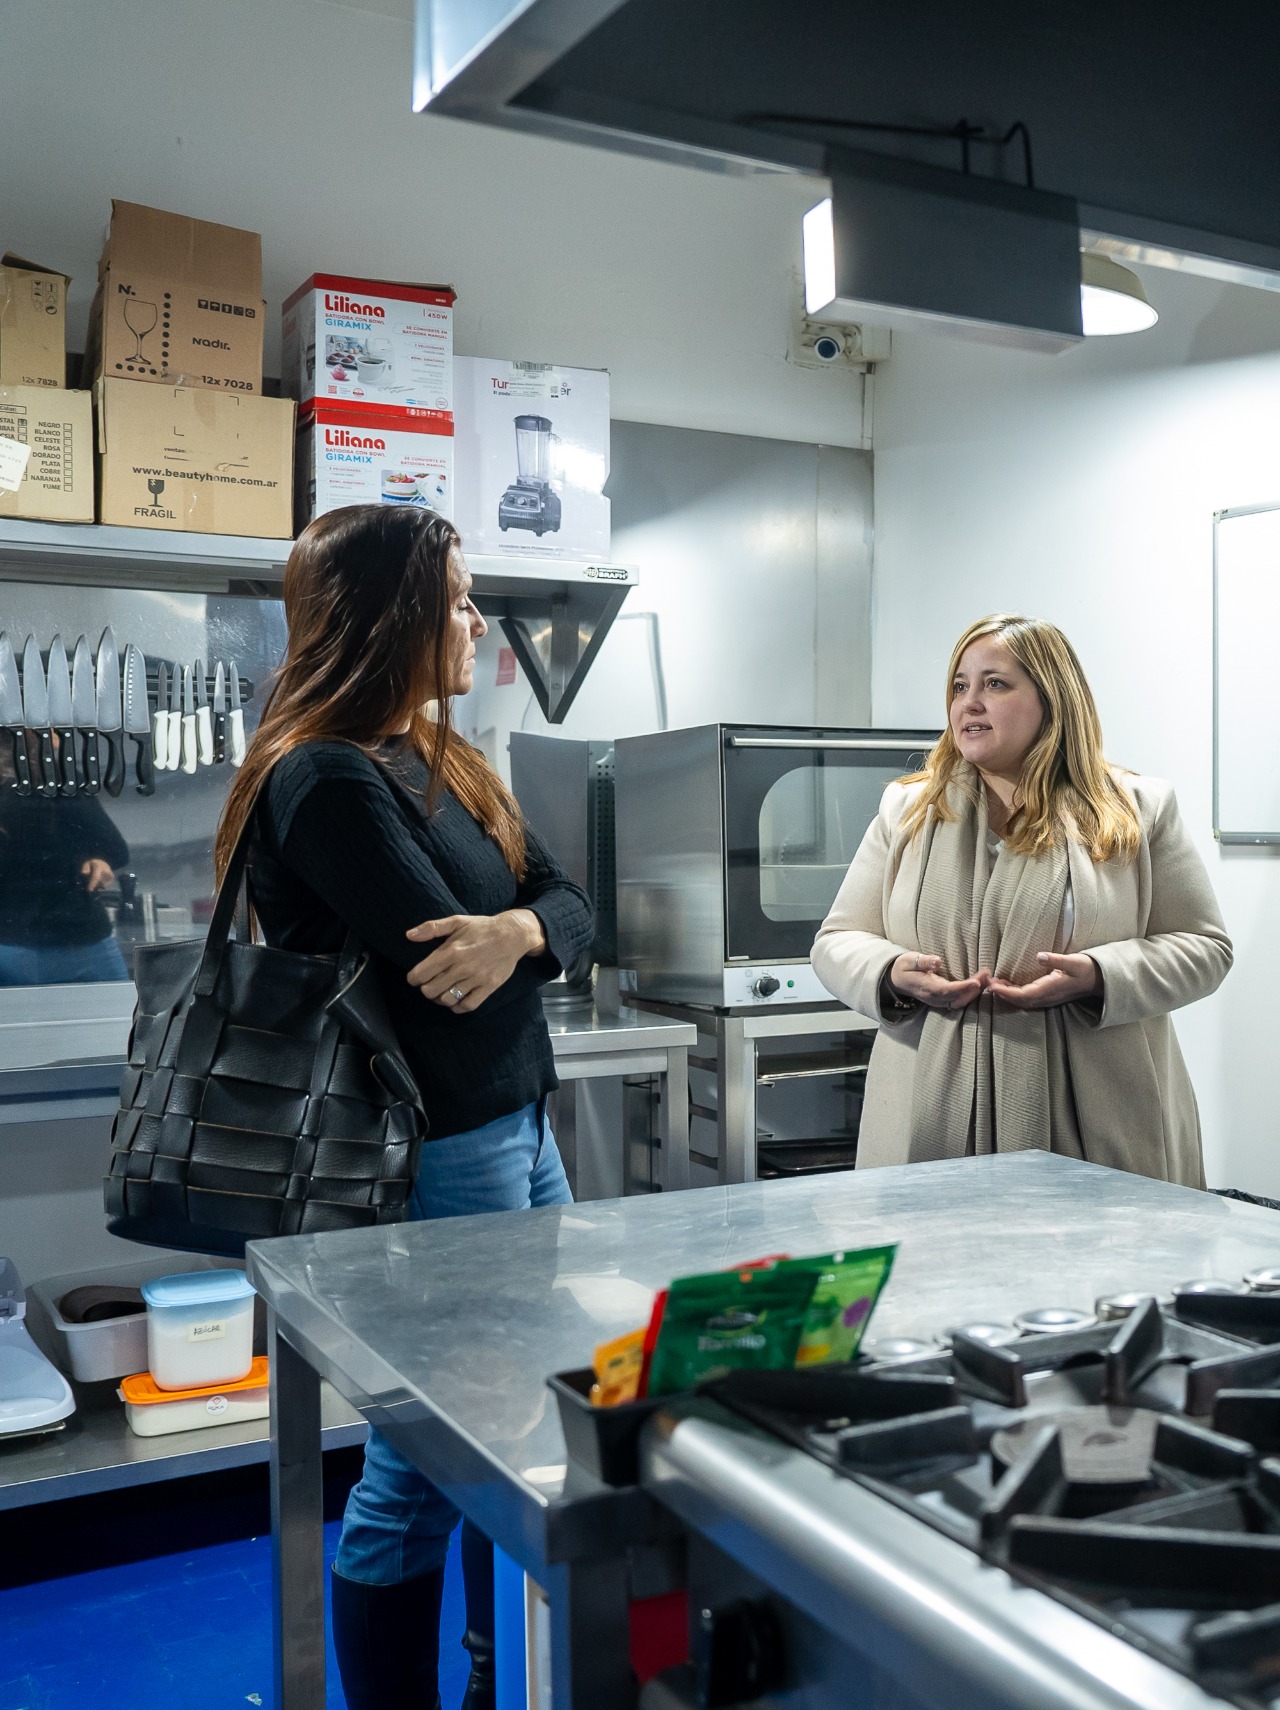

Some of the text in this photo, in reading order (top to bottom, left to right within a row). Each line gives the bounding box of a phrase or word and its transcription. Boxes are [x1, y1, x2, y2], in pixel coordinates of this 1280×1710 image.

[325, 294, 385, 318] Liliana
[325, 318, 372, 331] GIRAMIX
[21, 376, 35, 384] 12x
[201, 375, 253, 390] 12x 7028
[491, 378, 509, 389] Tur
[38, 421, 61, 429] NEGRO
[325, 429, 385, 450] Liliana
[326, 453, 372, 463] GIRAMIX
[30, 475, 61, 483] NARANJA
[132, 466, 279, 488] www.beautyhome.com.ar
[134, 507, 177, 519] FRAGIL
